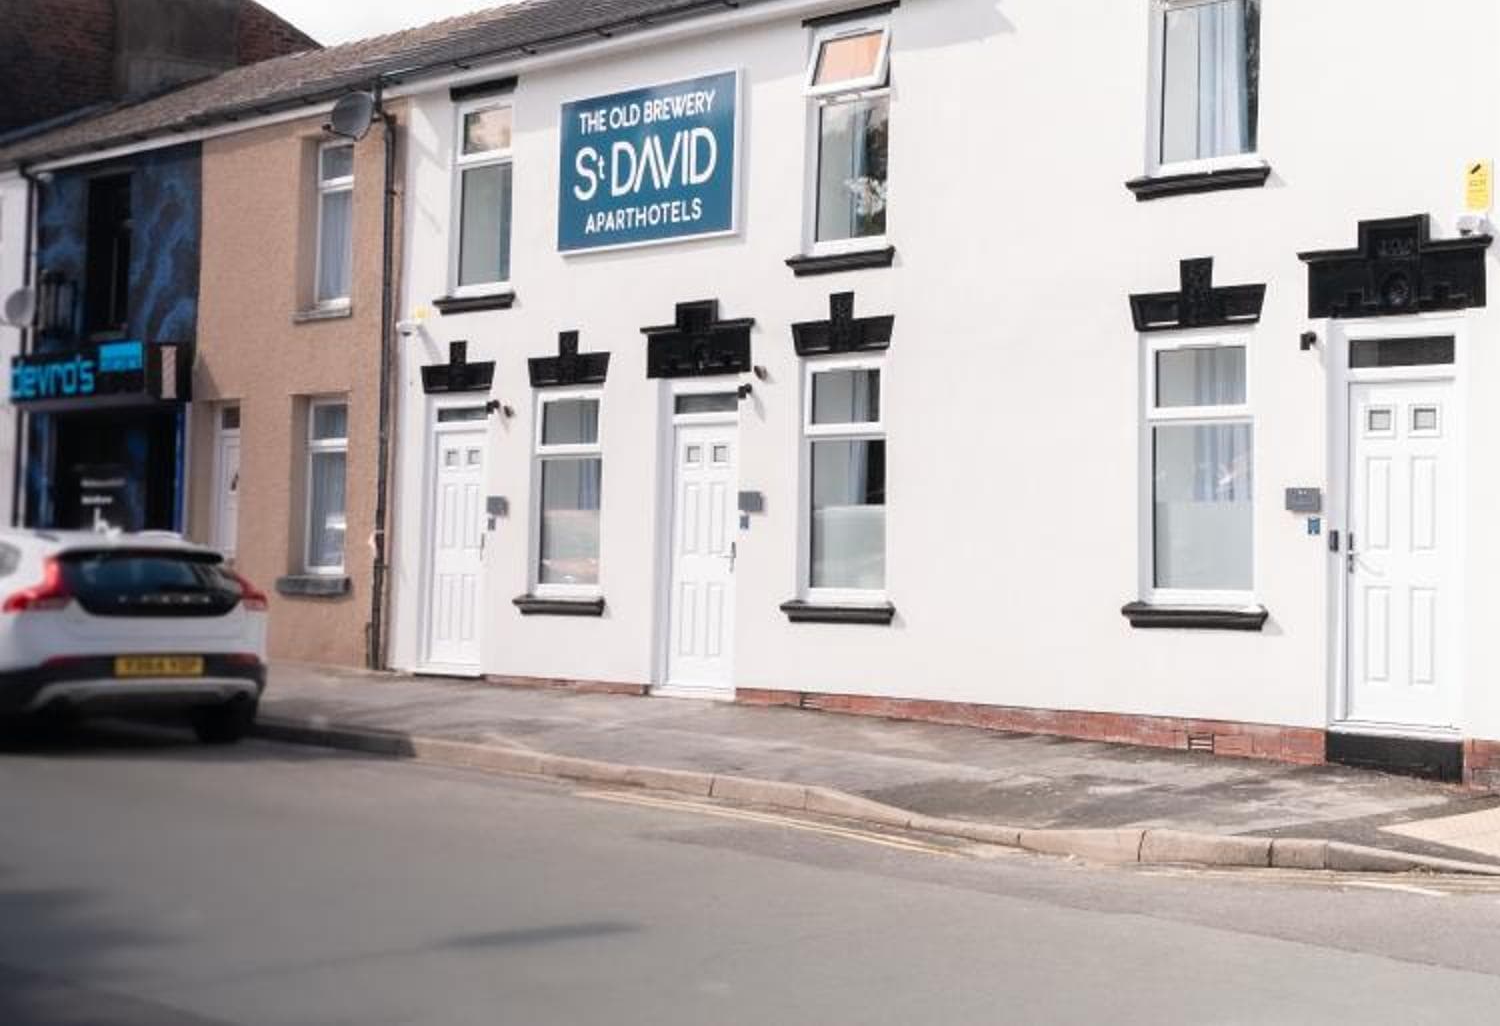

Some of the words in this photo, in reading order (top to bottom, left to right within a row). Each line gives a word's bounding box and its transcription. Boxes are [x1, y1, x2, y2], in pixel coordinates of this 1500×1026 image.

[579, 110, 606, 135] THE
[609, 103, 640, 129] OLD
[643, 89, 716, 123] BREWERY
[573, 146, 606, 201] St
[611, 127, 717, 197] DAVID
[585, 198, 702, 234] APARTHOTELS
